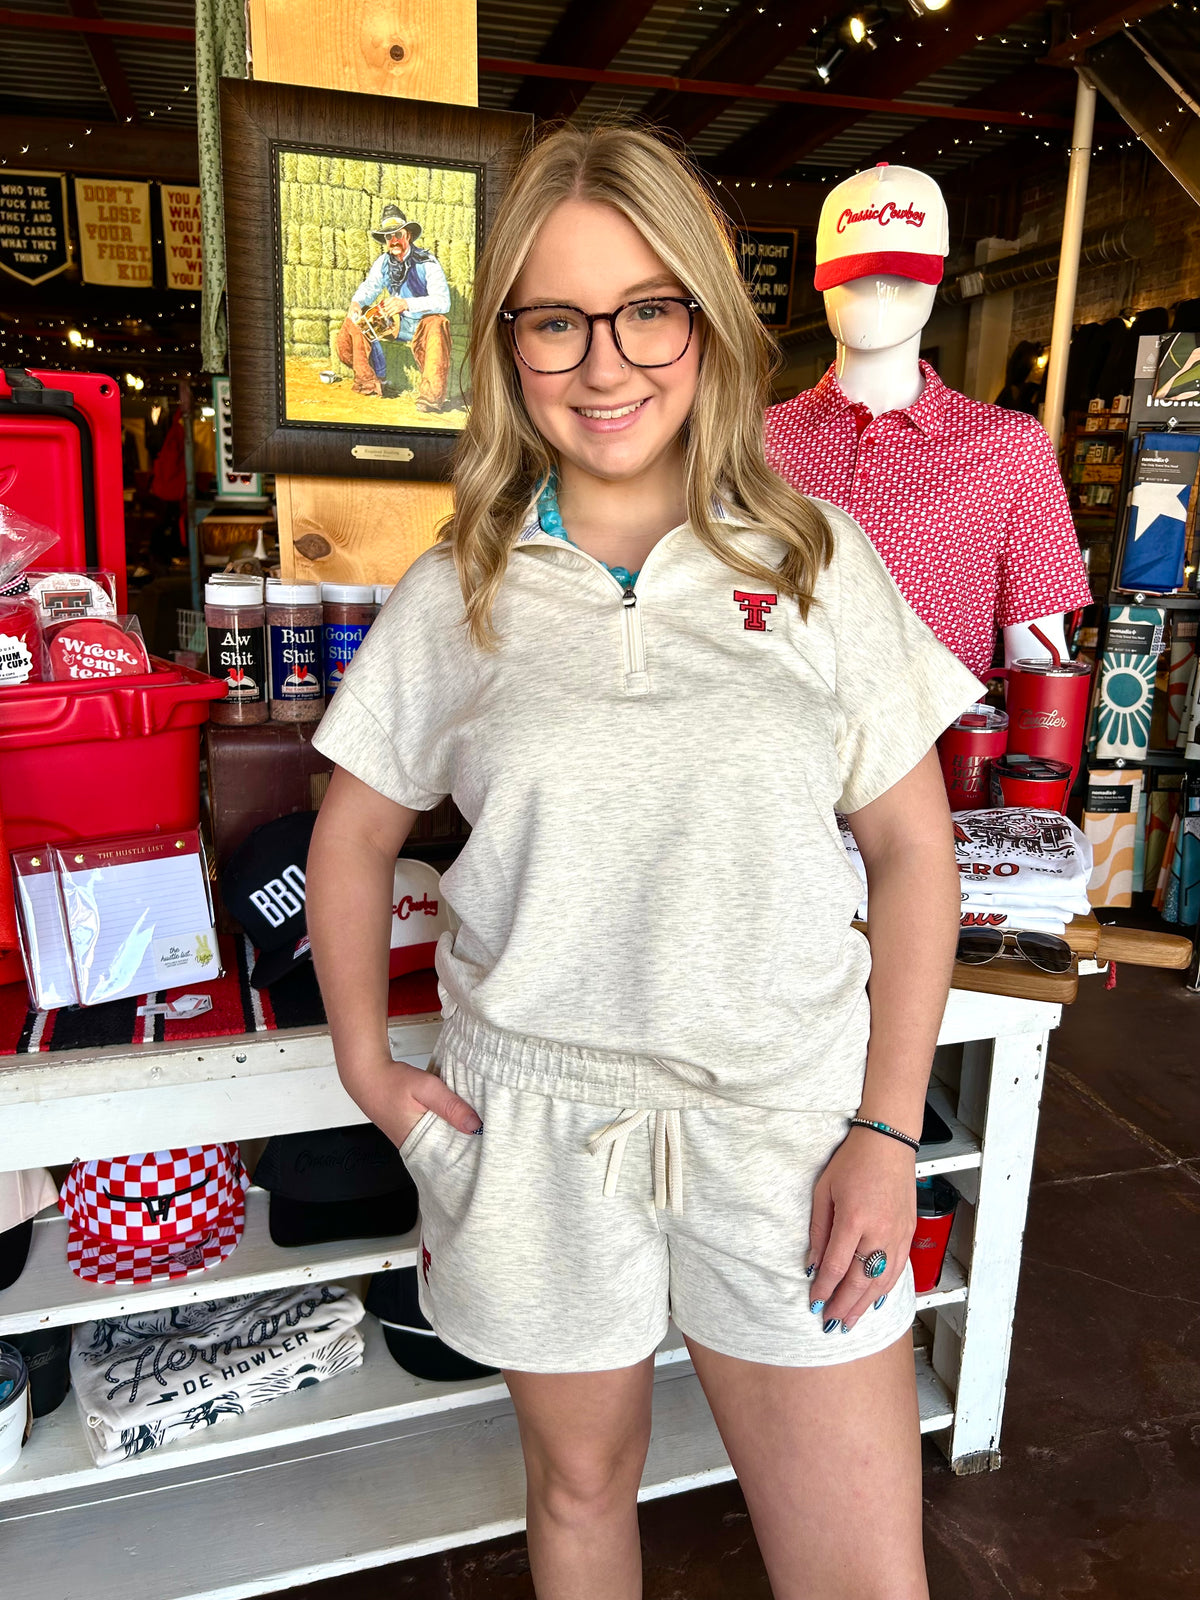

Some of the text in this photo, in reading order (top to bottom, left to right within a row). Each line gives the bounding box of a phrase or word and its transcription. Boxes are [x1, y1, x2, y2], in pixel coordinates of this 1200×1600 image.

[1, 184, 47, 197] WHO THE
[83, 185, 134, 205] DON'T
[0, 199, 51, 210] FUCK ARE
[168, 191, 190, 205] YOU
[33, 213, 53, 223] AND
[98, 205, 142, 225] LOSE
[169, 205, 200, 219] WHA
[836, 201, 926, 234] Classic Cowboy
[0, 225, 57, 237] WHO CARES
[85, 223, 133, 243] YOUR
[169, 220, 193, 233] YOU
[1, 238, 57, 250] WHAT THEY
[183, 235, 201, 245] AN
[13, 252, 49, 263] THINK?
[171, 246, 193, 259] YOU
[741, 243, 789, 258] DO RIGHT
[172, 272, 194, 285] YOU
[773, 284, 788, 296] NO
[220, 631, 251, 646] Aw
[281, 629, 315, 643] Bull
[325, 626, 364, 642] Good
[58, 636, 138, 665] Wreck
[283, 649, 316, 663] Shit
[7, 657, 29, 669] CUPS
[220, 651, 255, 665] Shit
[97, 844, 164, 860] THE HUSTLE LIST
[104, 1286, 345, 1403] Hermanos
[183, 1331, 309, 1397] DE HOWLER
